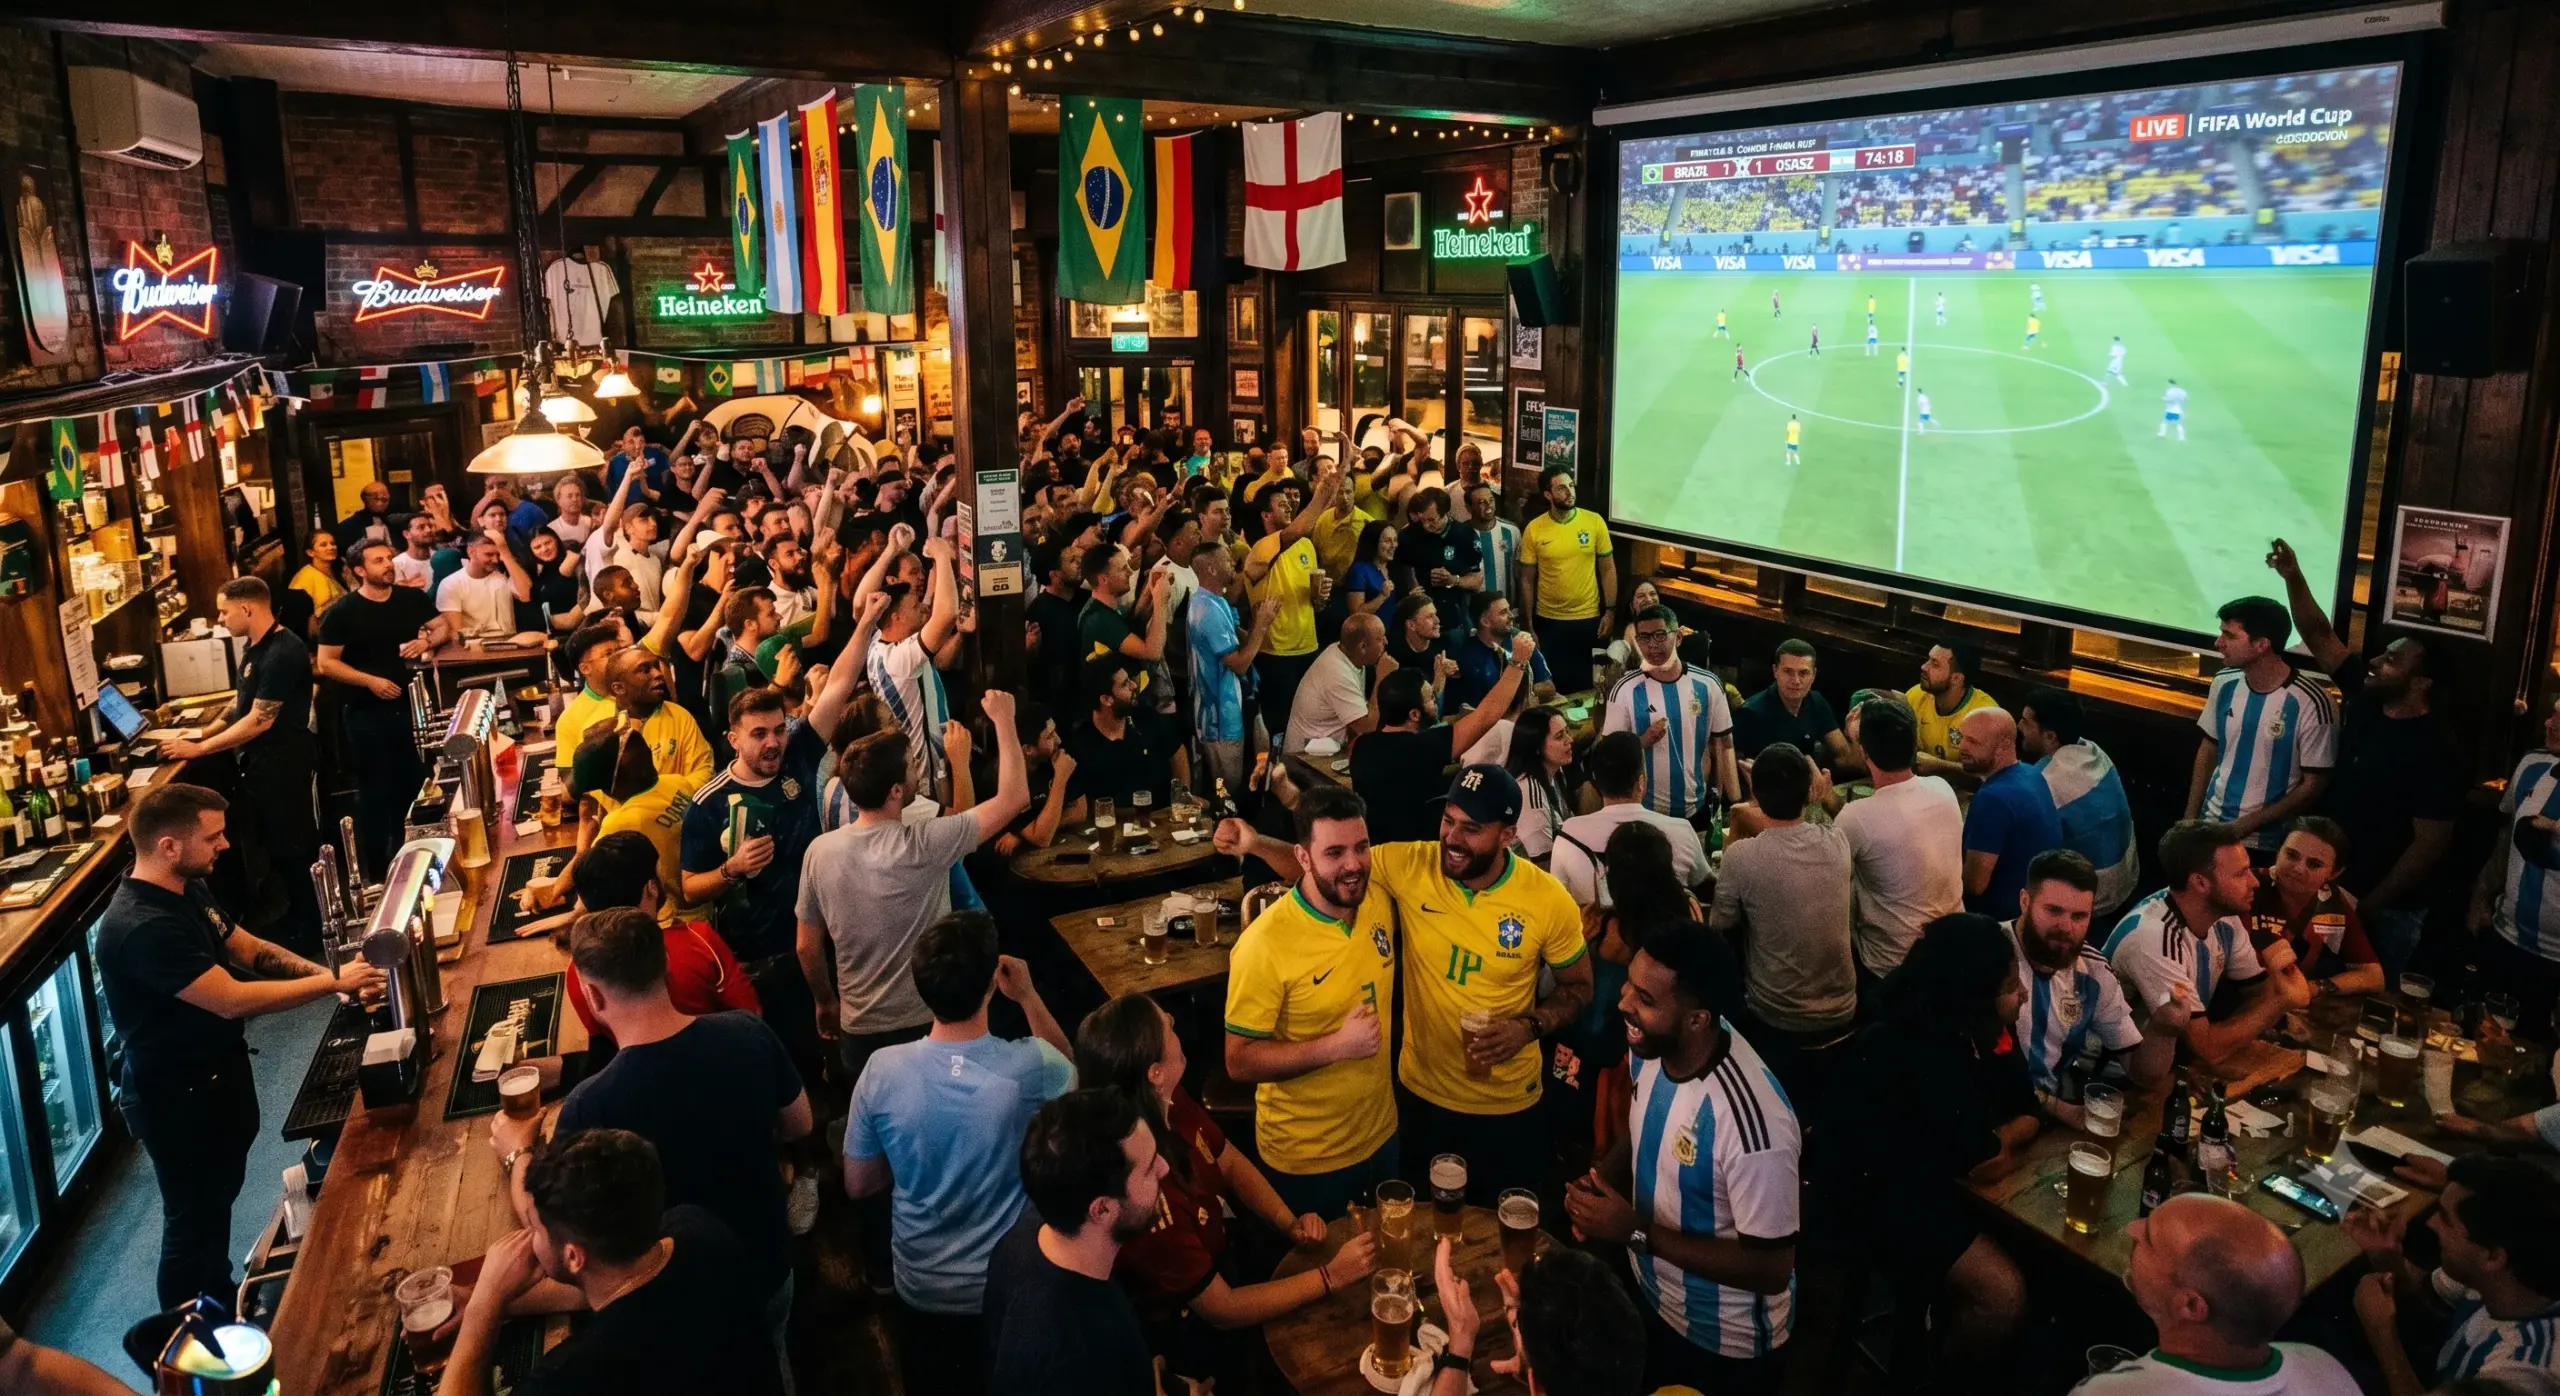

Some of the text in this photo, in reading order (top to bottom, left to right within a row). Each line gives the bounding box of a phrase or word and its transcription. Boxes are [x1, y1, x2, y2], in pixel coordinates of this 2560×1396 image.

[2135, 107, 2353, 138] LIVE FIFA World Cup
[1755, 160, 1762, 174] 1
[1865, 150, 1905, 166] 74:18
[1434, 227, 1530, 258] Heineken
[1651, 254, 1816, 270] VISA VISA VISA
[2040, 245, 2341, 268] VISA VISA VISA
[113, 268, 217, 314] Budweiser
[352, 280, 501, 308] Budweiser
[658, 295, 762, 316] Heineken
